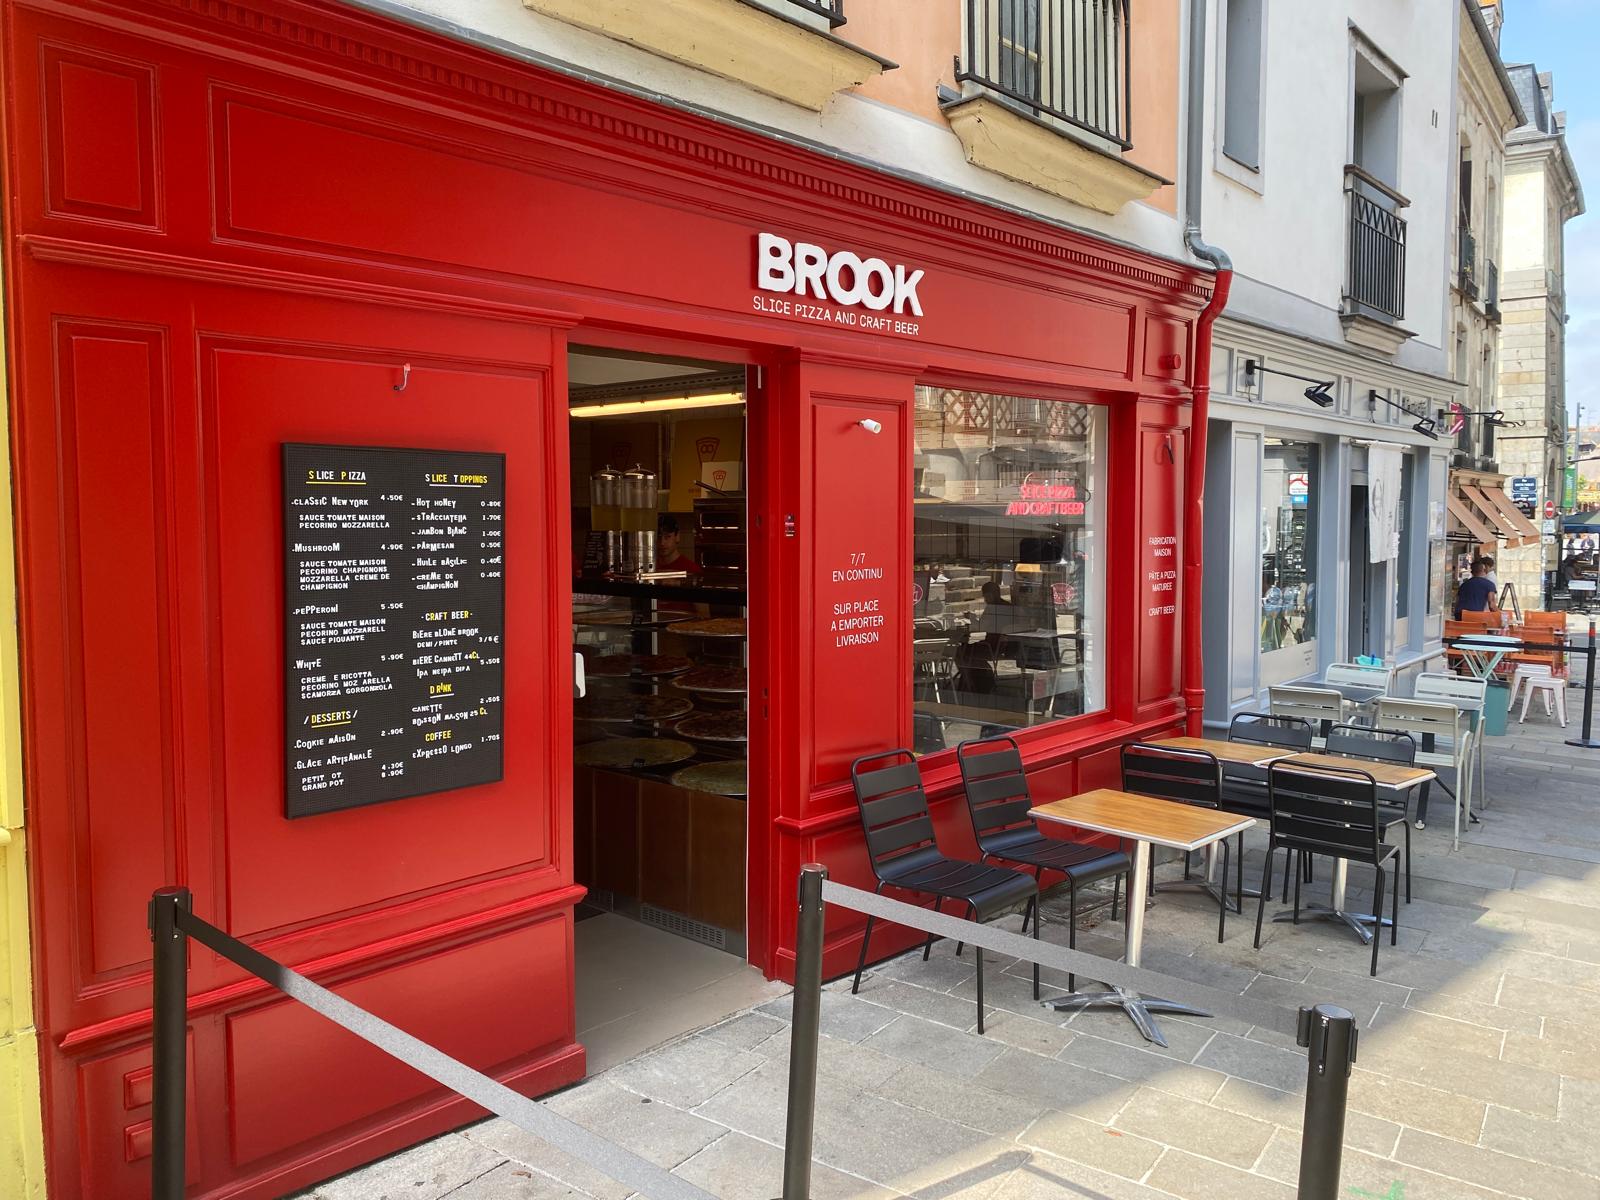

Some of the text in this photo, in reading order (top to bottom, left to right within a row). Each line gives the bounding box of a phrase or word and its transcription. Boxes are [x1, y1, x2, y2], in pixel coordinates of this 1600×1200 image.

[757, 232, 925, 317] BROOK
[753, 295, 919, 336] SLICE PIZZA AND CRAFT BEER
[308, 470, 366, 480] SLICE PIZZA
[425, 473, 488, 484] SLICE TOPPINGS
[1048, 485, 1076, 500] PIZZA
[350, 499, 369, 508] YORK
[434, 498, 457, 509] HONEY
[1006, 502, 1030, 516] AND
[1060, 502, 1085, 516] BEER
[1148, 536, 1177, 546] FABRICATION
[1154, 548, 1172, 557] MAISON
[850, 552, 866, 567] 7/7
[300, 566, 388, 576] PECORINO CHAPIGNONS
[832, 568, 883, 582] EN CONTINU
[300, 574, 350, 583] MOZZARELLA
[300, 582, 349, 591] CHAMPIGNON
[834, 600, 879, 616] SUR PLACE
[1148, 606, 1175, 617] CRAFT BEER
[300, 618, 387, 630] SAUCE TOMATE MAISON
[830, 616, 884, 632] A EMPORTER
[300, 629, 339, 638] PECORINO
[836, 631, 879, 648] LIVRAISON
[300, 634, 366, 646] SAUCE PIQUANTE
[412, 655, 433, 666] BIERE
[301, 675, 327, 684] CREME
[340, 671, 373, 680] RICOTTA
[301, 682, 339, 692] PECORINO
[301, 683, 393, 700] SCAMORZA GORGONZOLA
[328, 732, 356, 744] MAISON
[426, 730, 452, 742] COFFEE
[326, 748, 373, 766] ARTISANALE
[412, 743, 472, 759] EXPRESSO LONGO
[302, 774, 325, 785] PETIT
[302, 778, 344, 792] GRAND POT
